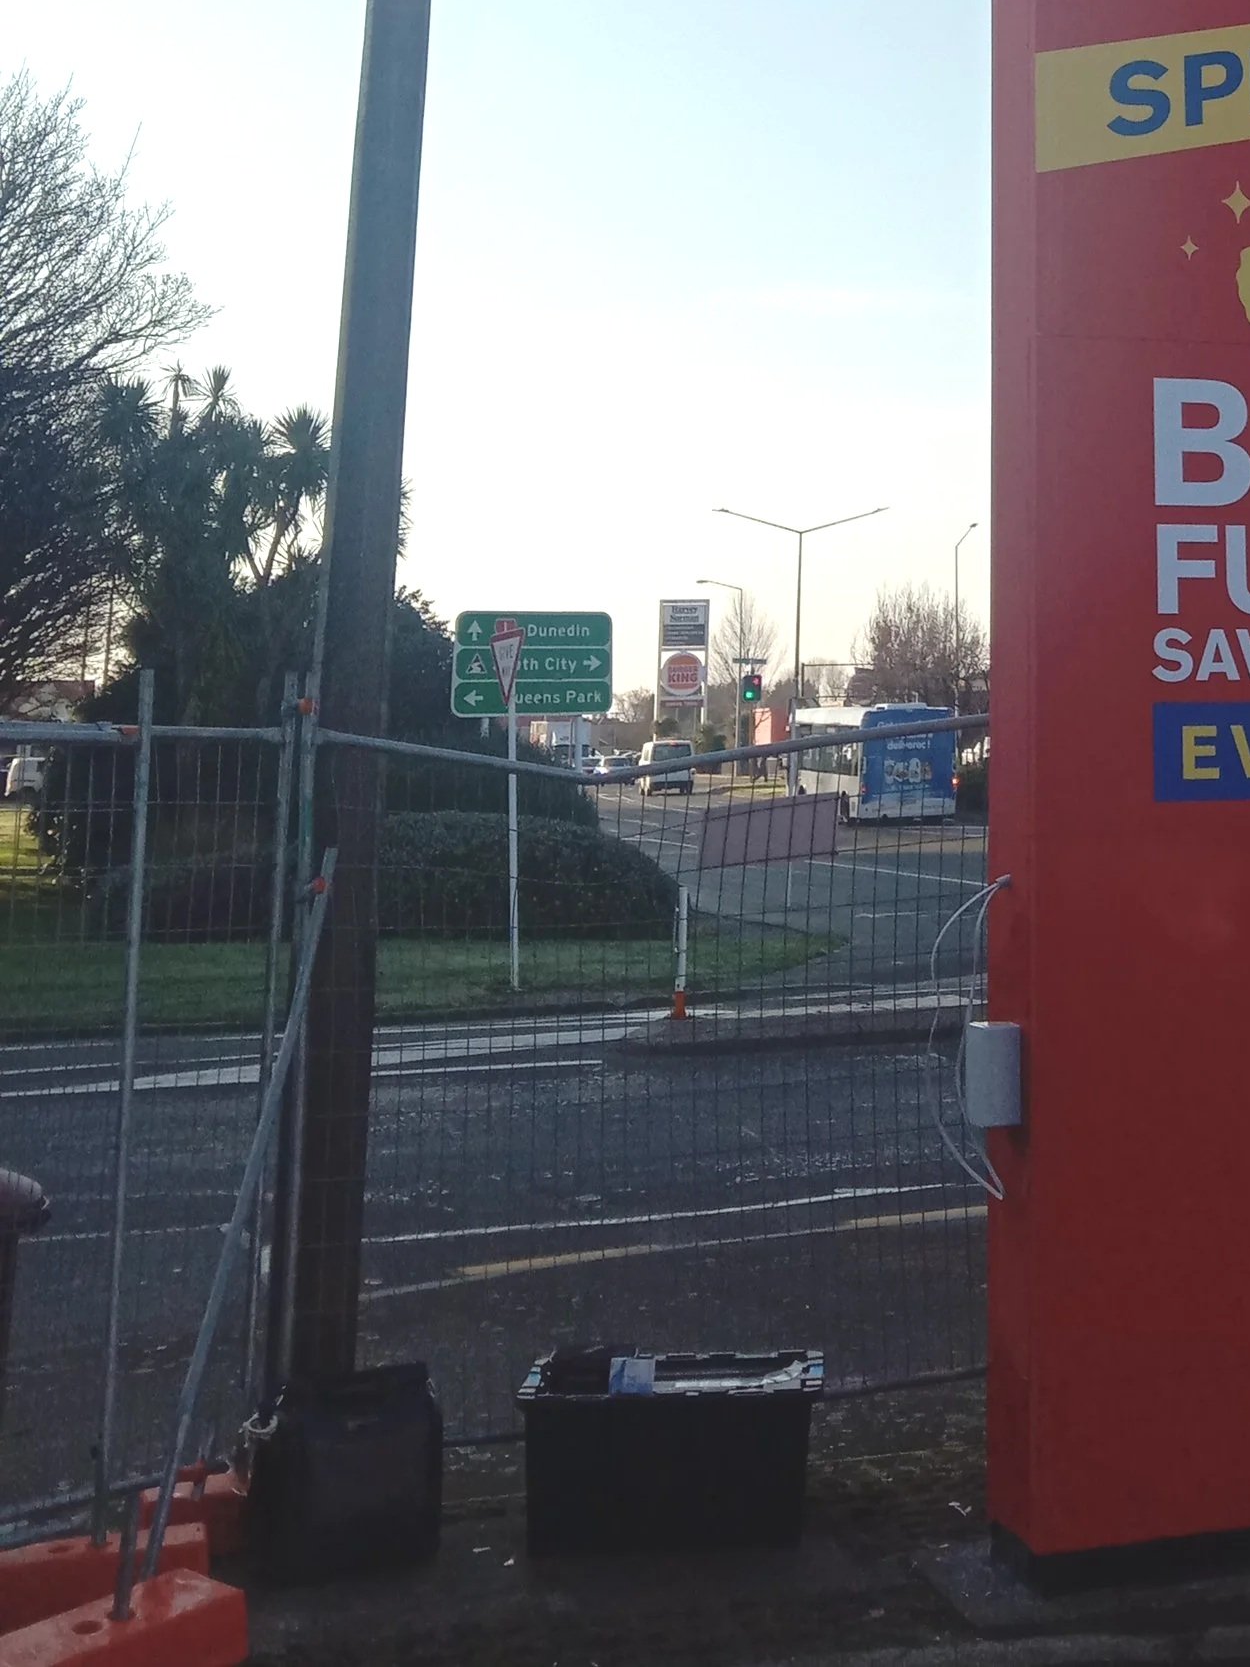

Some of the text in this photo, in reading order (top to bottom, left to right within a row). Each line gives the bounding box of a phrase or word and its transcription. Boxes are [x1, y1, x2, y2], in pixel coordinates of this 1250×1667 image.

[527, 624, 590, 637] Dunedin
[545, 657, 577, 673] City
[668, 672, 697, 683] KING
[515, 690, 602, 704] ueens Park
